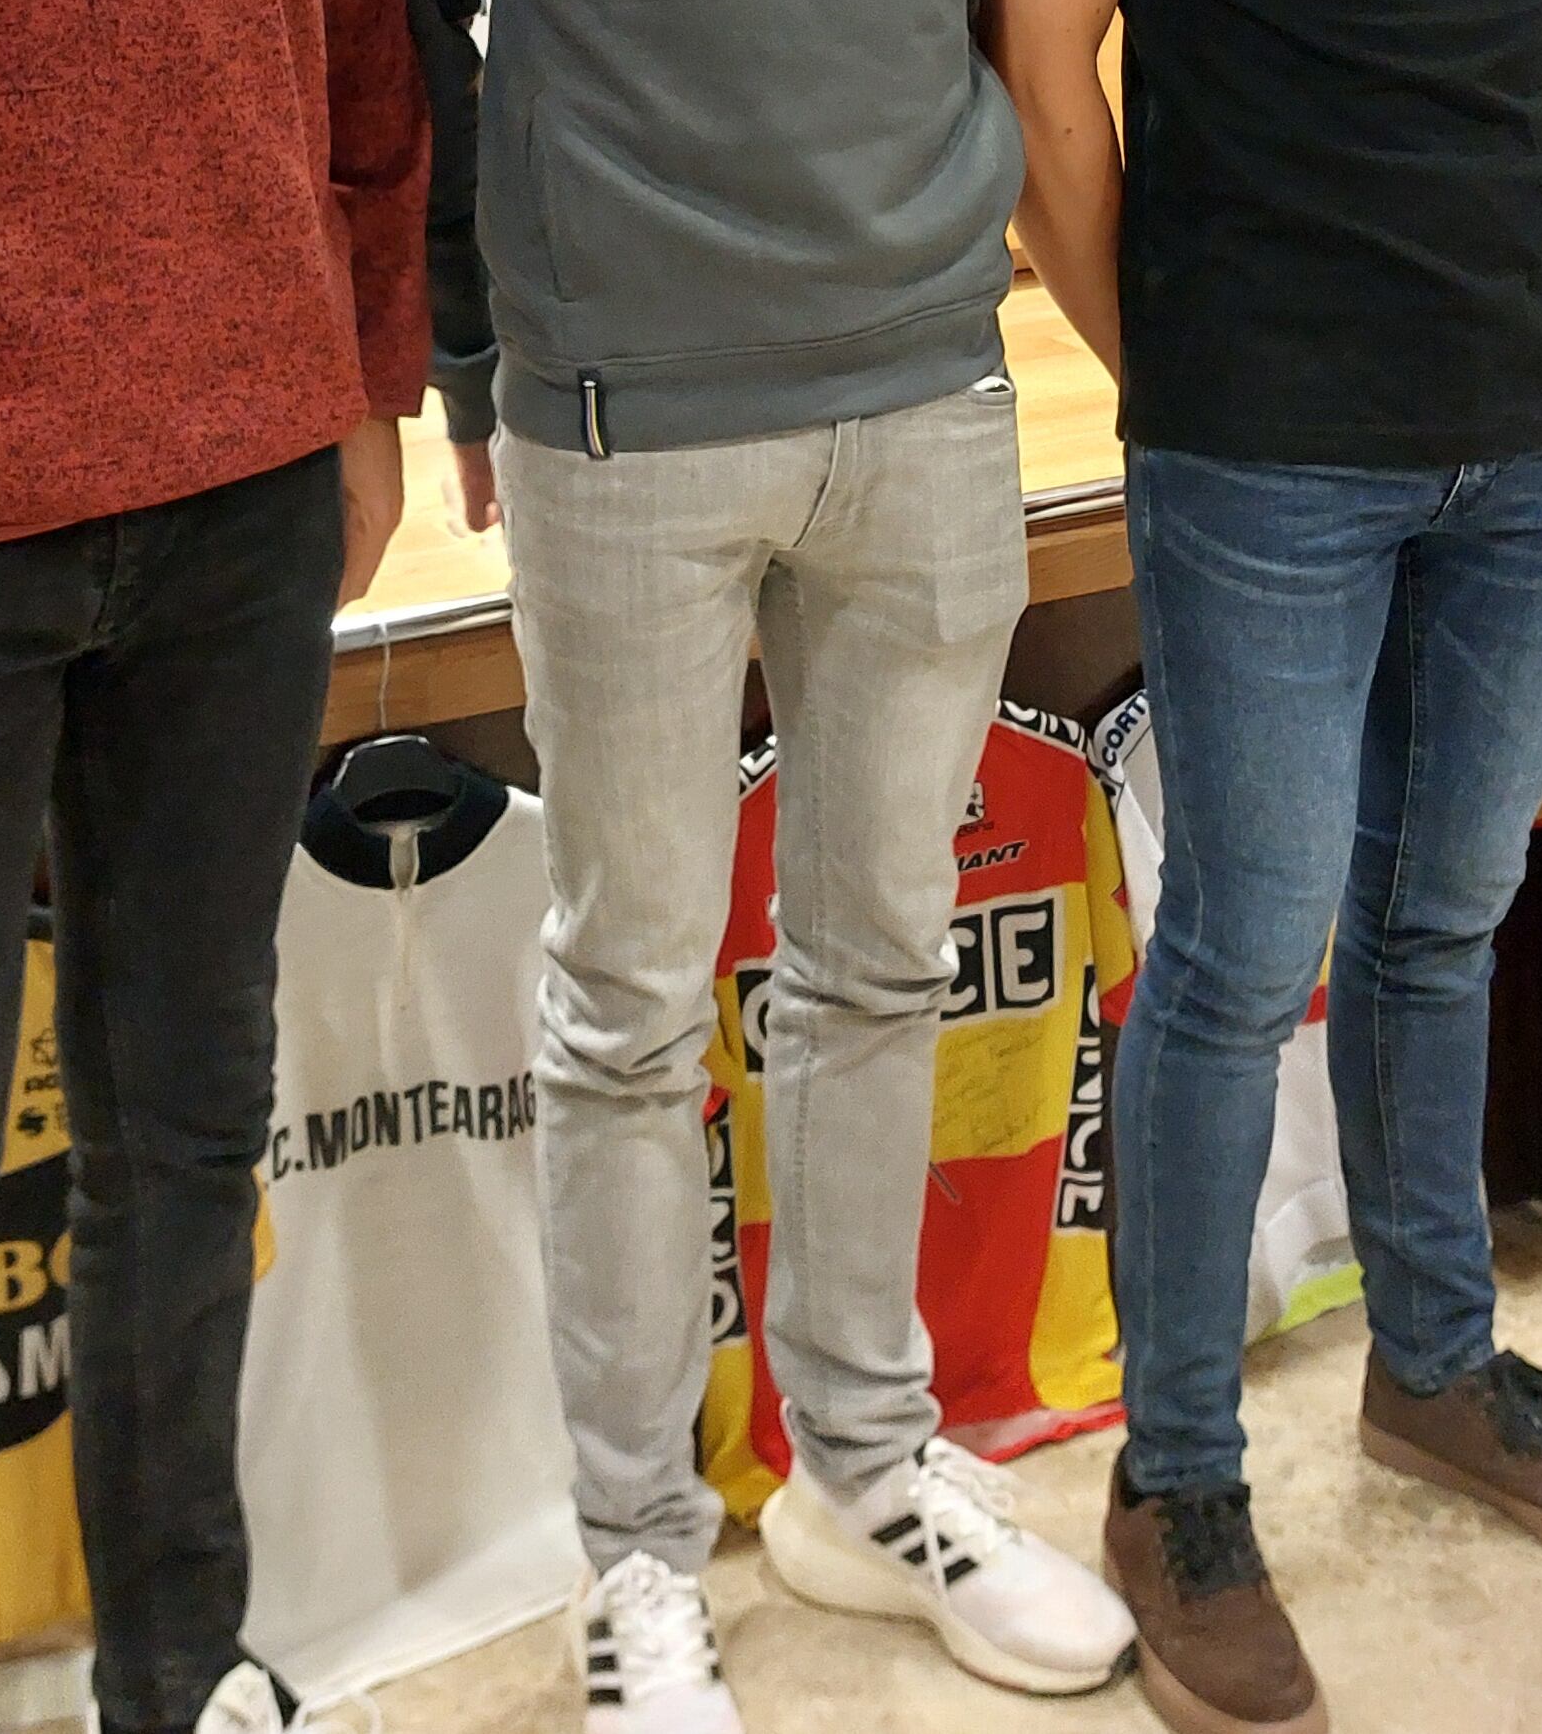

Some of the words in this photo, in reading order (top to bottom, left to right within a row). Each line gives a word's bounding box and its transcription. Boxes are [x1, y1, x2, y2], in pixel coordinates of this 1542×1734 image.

[1102, 693, 1149, 768] CORT
[958, 841, 1027, 871] IANT
[269, 1070, 536, 1182] C.MONTEARAG
